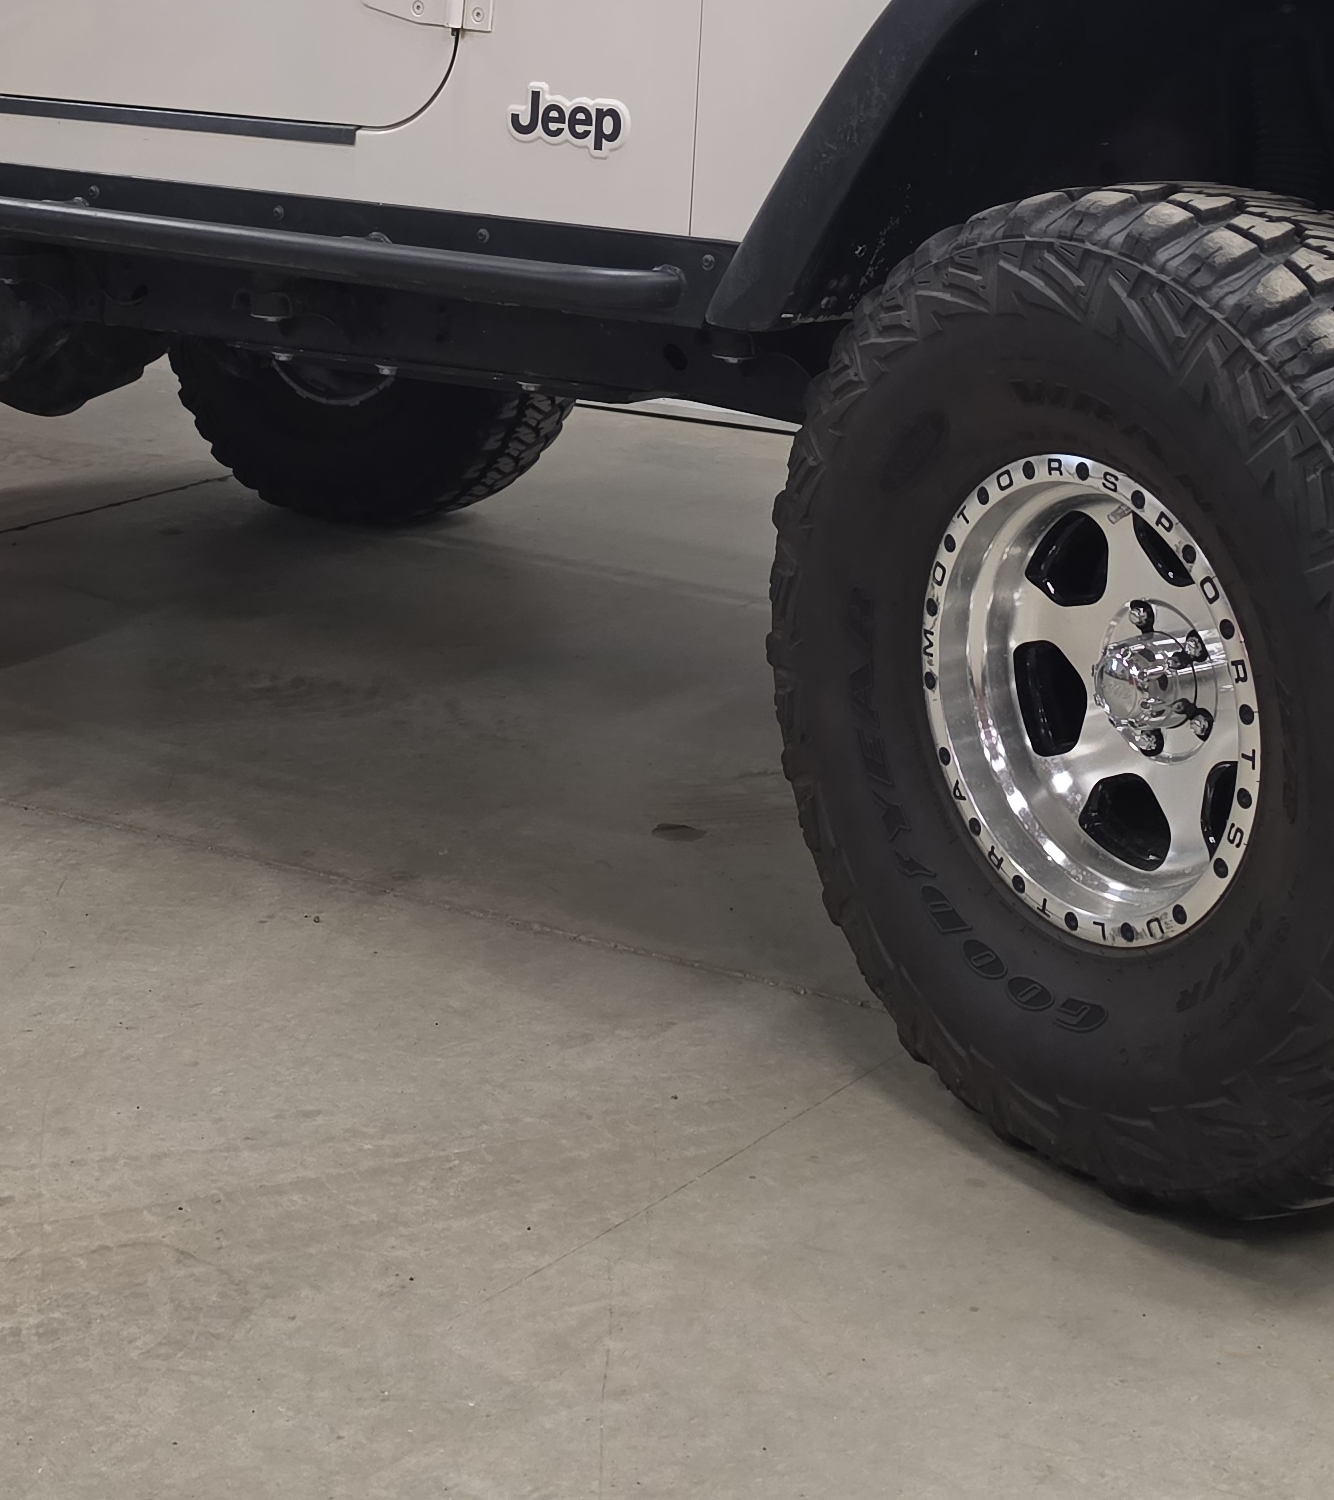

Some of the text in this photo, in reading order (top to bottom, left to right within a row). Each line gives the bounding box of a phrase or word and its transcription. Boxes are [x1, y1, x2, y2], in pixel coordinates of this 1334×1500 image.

[510, 89, 623, 152] Jeep
[847, 585, 1110, 1034] GOODYEAR
[921, 456, 1259, 943] ULTRA MOTORSPORTS
